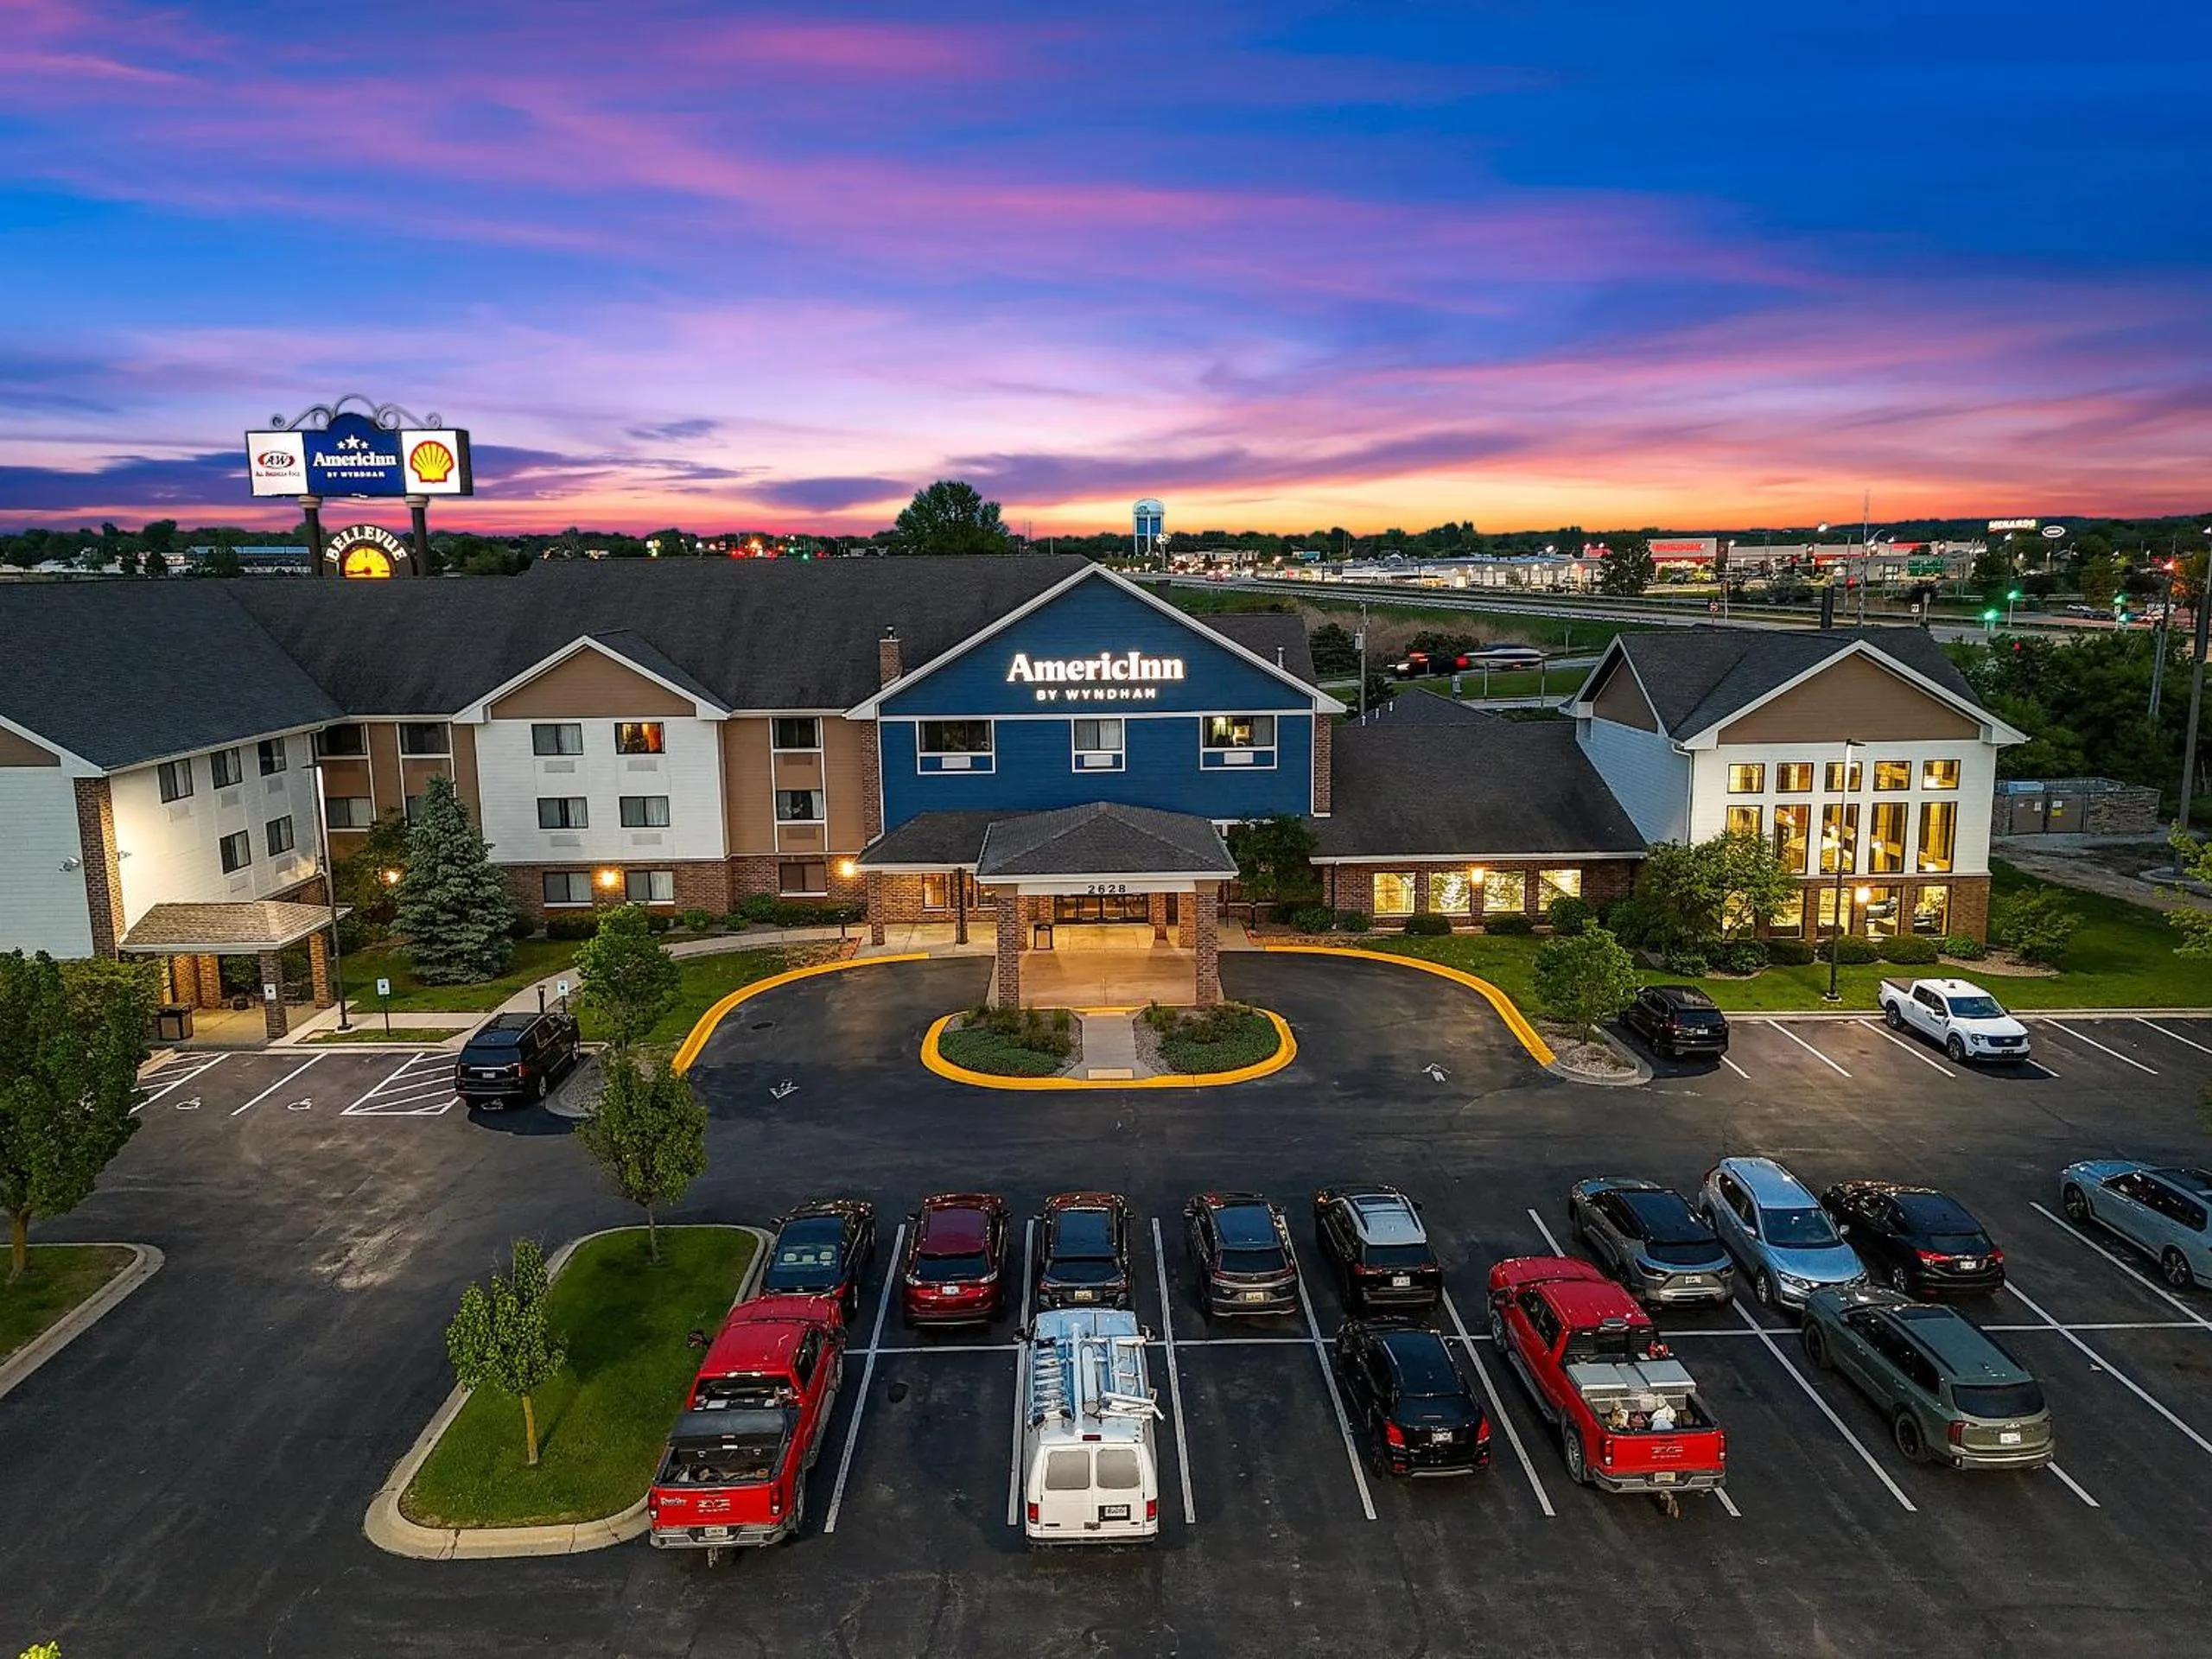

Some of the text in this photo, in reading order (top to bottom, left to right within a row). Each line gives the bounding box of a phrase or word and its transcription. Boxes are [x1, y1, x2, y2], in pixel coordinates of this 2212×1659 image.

[313, 451, 397, 467] AmericInn
[325, 525, 408, 562] BELLEVUE
[1006, 651, 1185, 683] AmericInn
[1036, 689, 1156, 701] BY WYNDHAM
[1087, 884, 1127, 894] 2628
